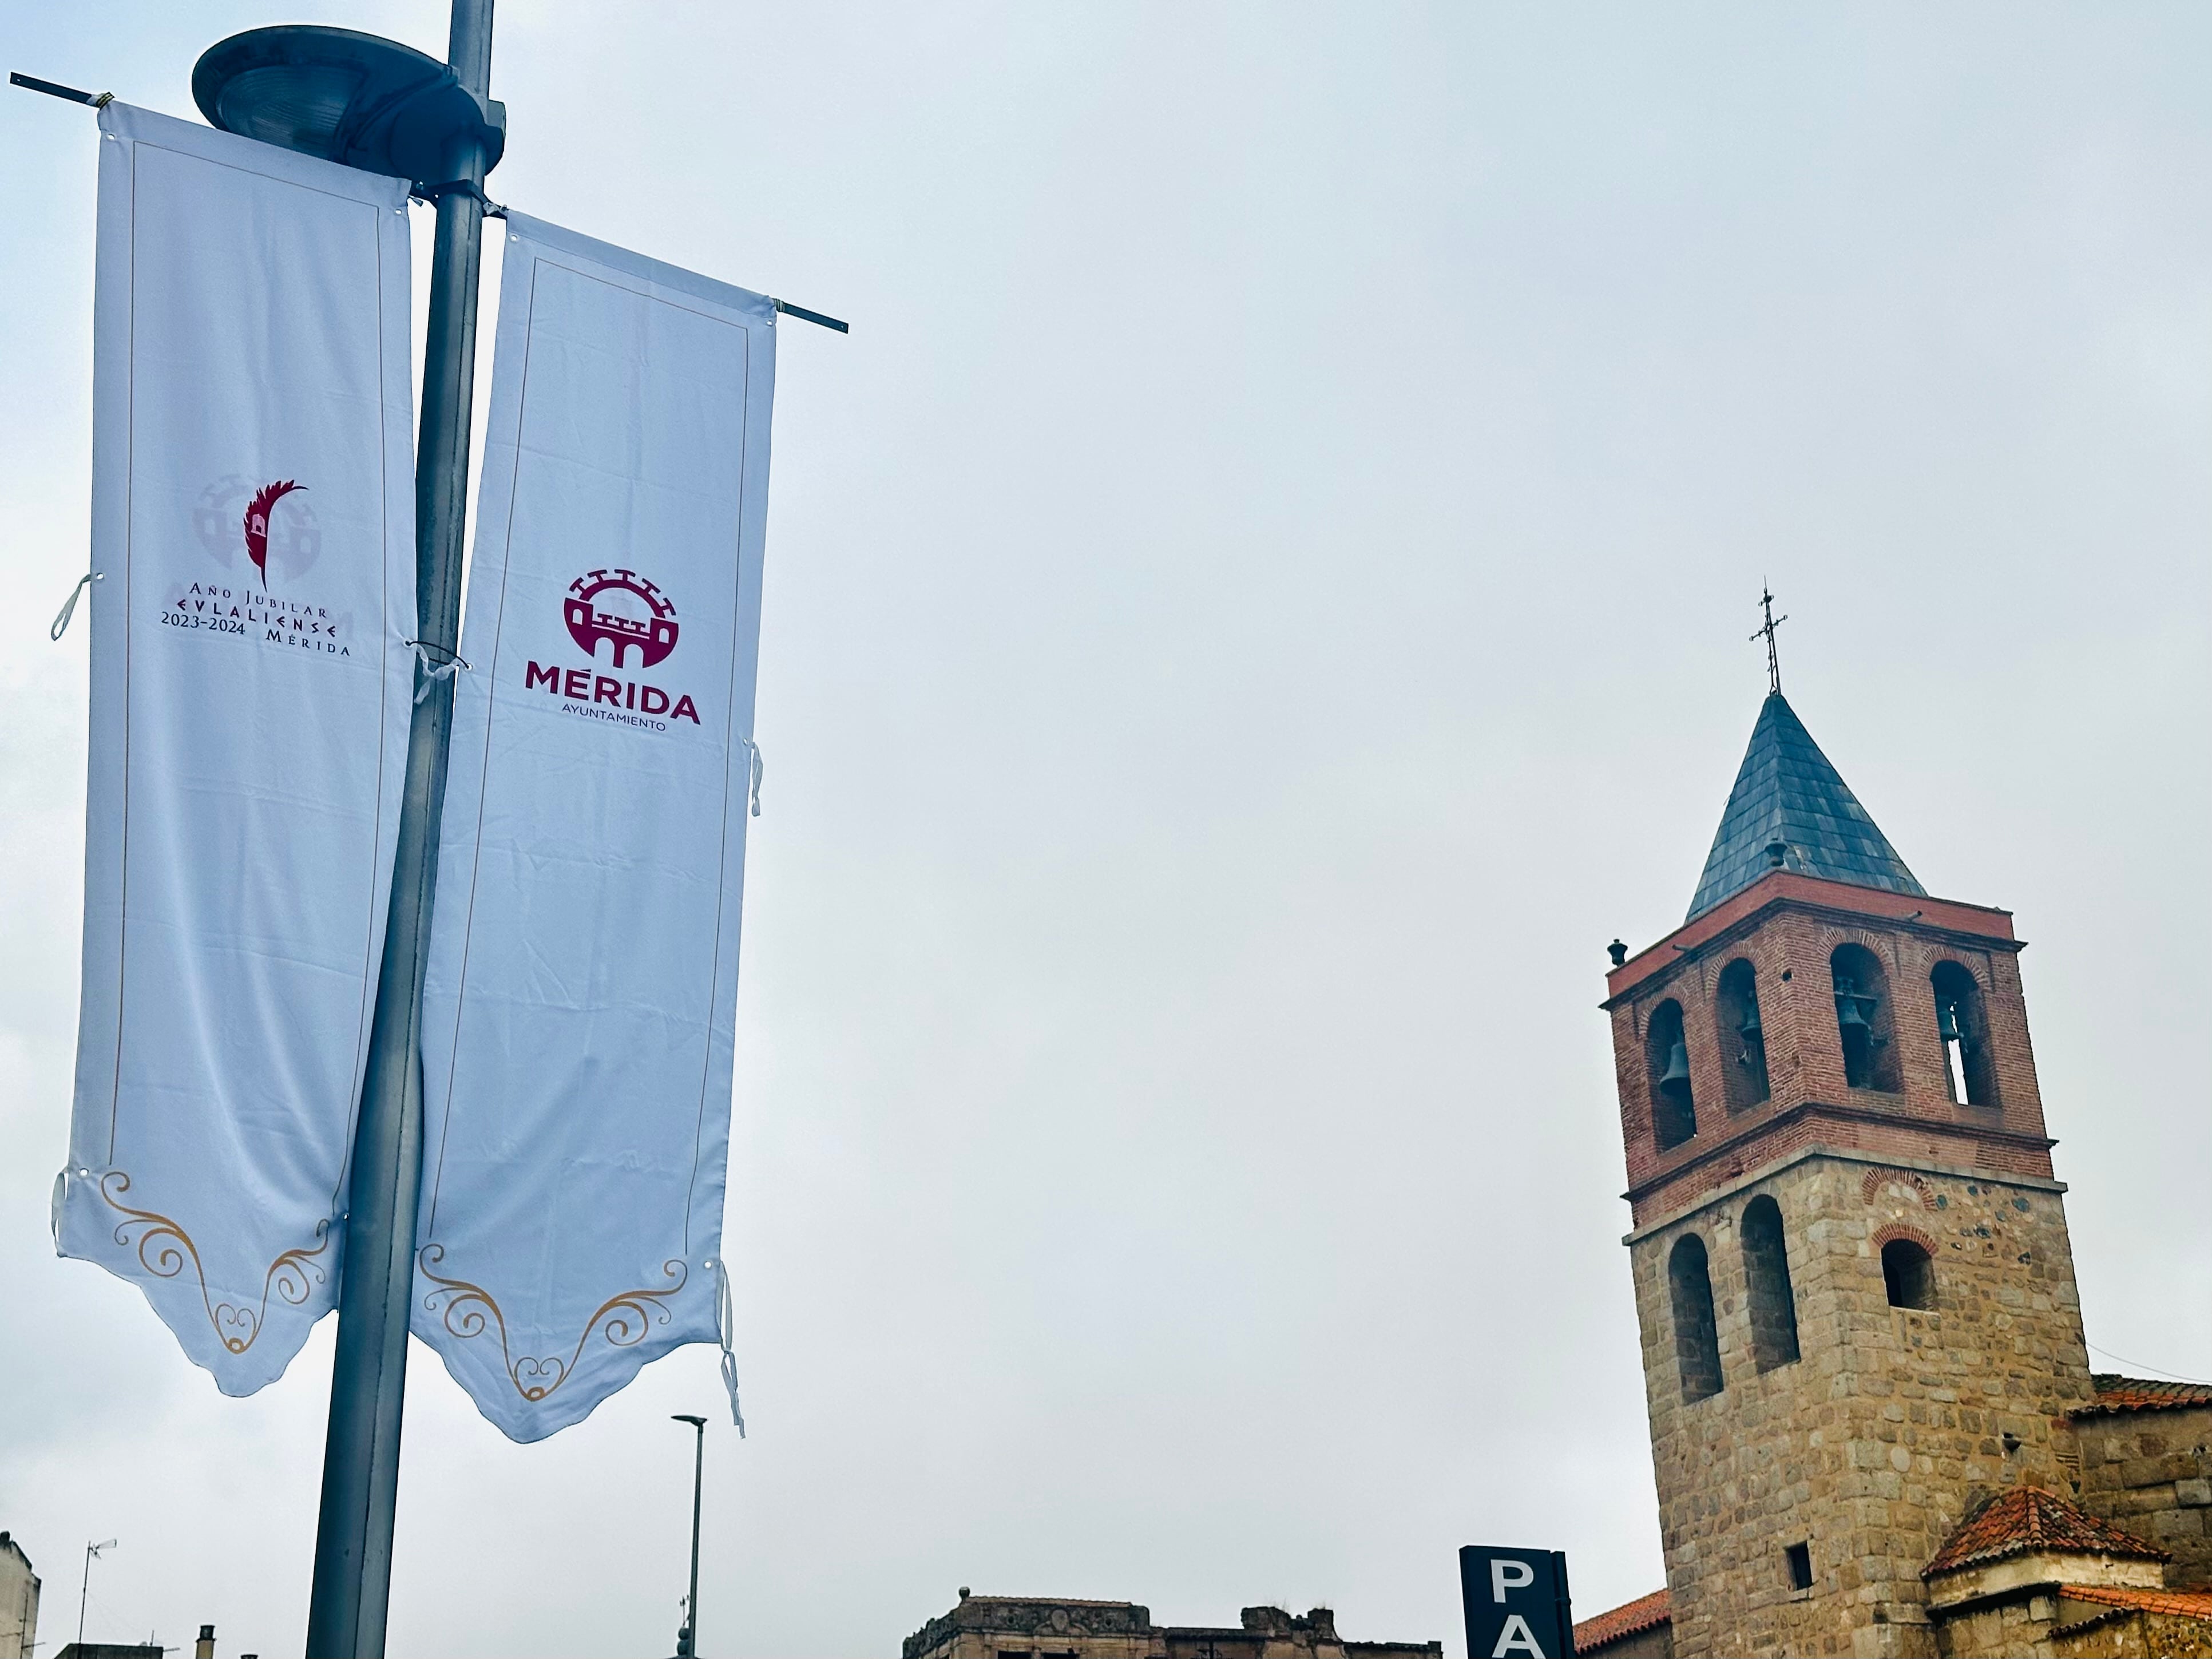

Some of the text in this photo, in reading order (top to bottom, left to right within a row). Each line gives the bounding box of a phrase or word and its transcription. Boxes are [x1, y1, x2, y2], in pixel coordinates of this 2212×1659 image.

[245, 591, 327, 618] JUBILAR
[161, 611, 245, 635] 2023-2024
[525, 660, 701, 725] MÉRIDA
[562, 703, 666, 731] AYUNTAMIENTO
